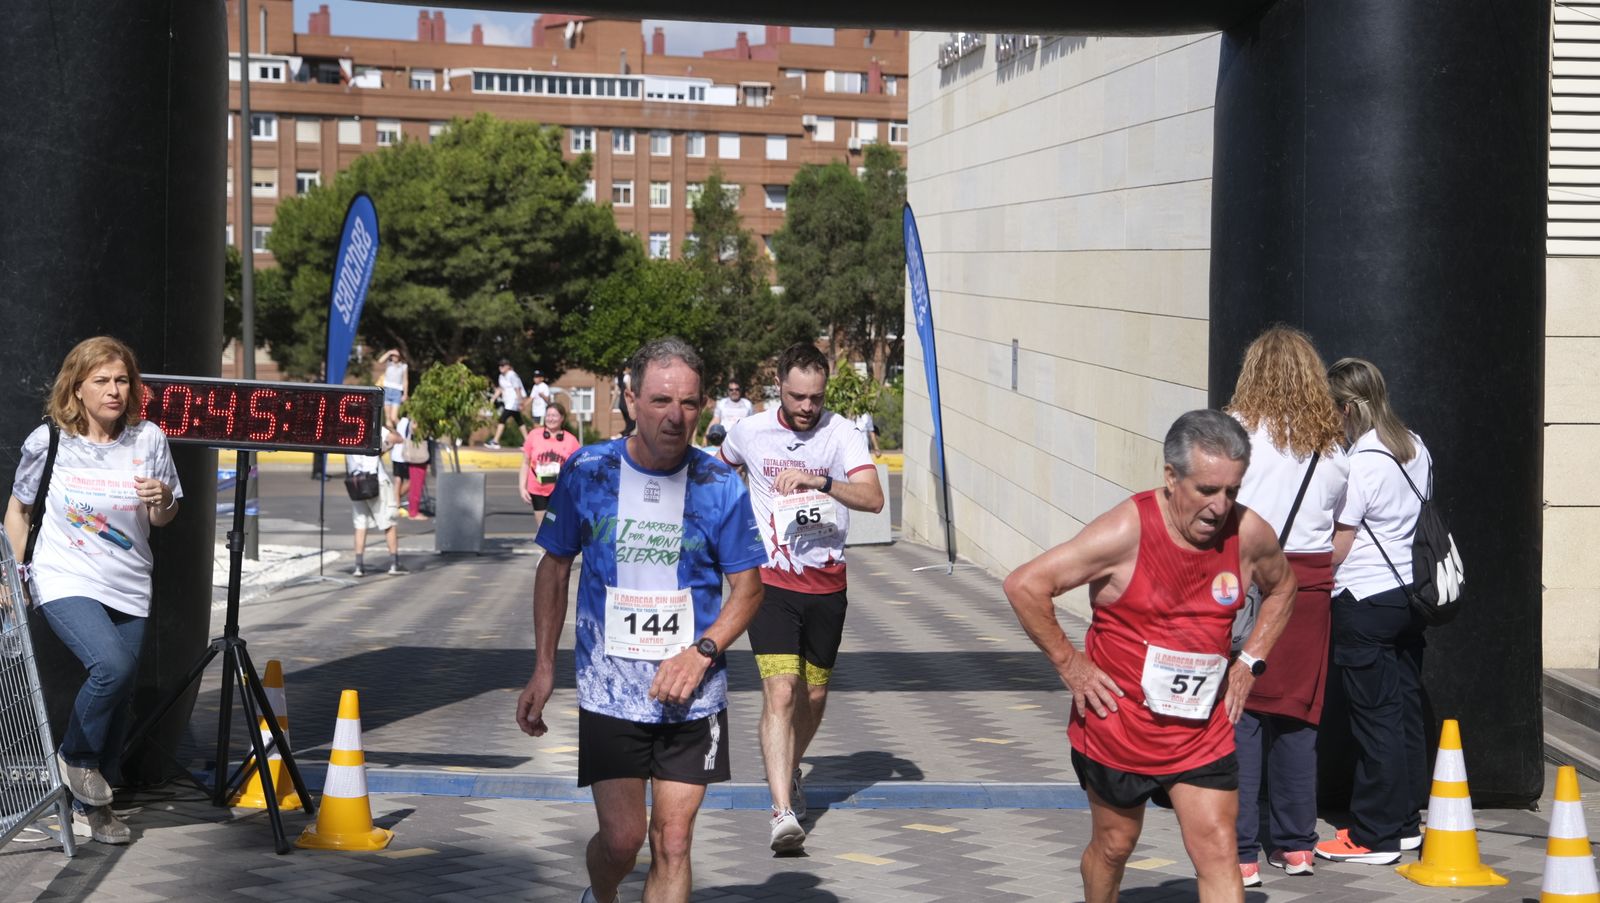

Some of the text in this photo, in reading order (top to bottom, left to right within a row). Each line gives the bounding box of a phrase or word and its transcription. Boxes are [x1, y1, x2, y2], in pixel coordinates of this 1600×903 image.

[763, 458, 806, 468] TOTALENERGIES
[763, 466, 787, 478] MED
[795, 507, 821, 526] 65
[637, 520, 687, 534] CARRERA
[628, 532, 645, 541] POR
[615, 546, 680, 567] SIERRO
[624, 612, 680, 636] 144
[1170, 674, 1207, 696] 57
